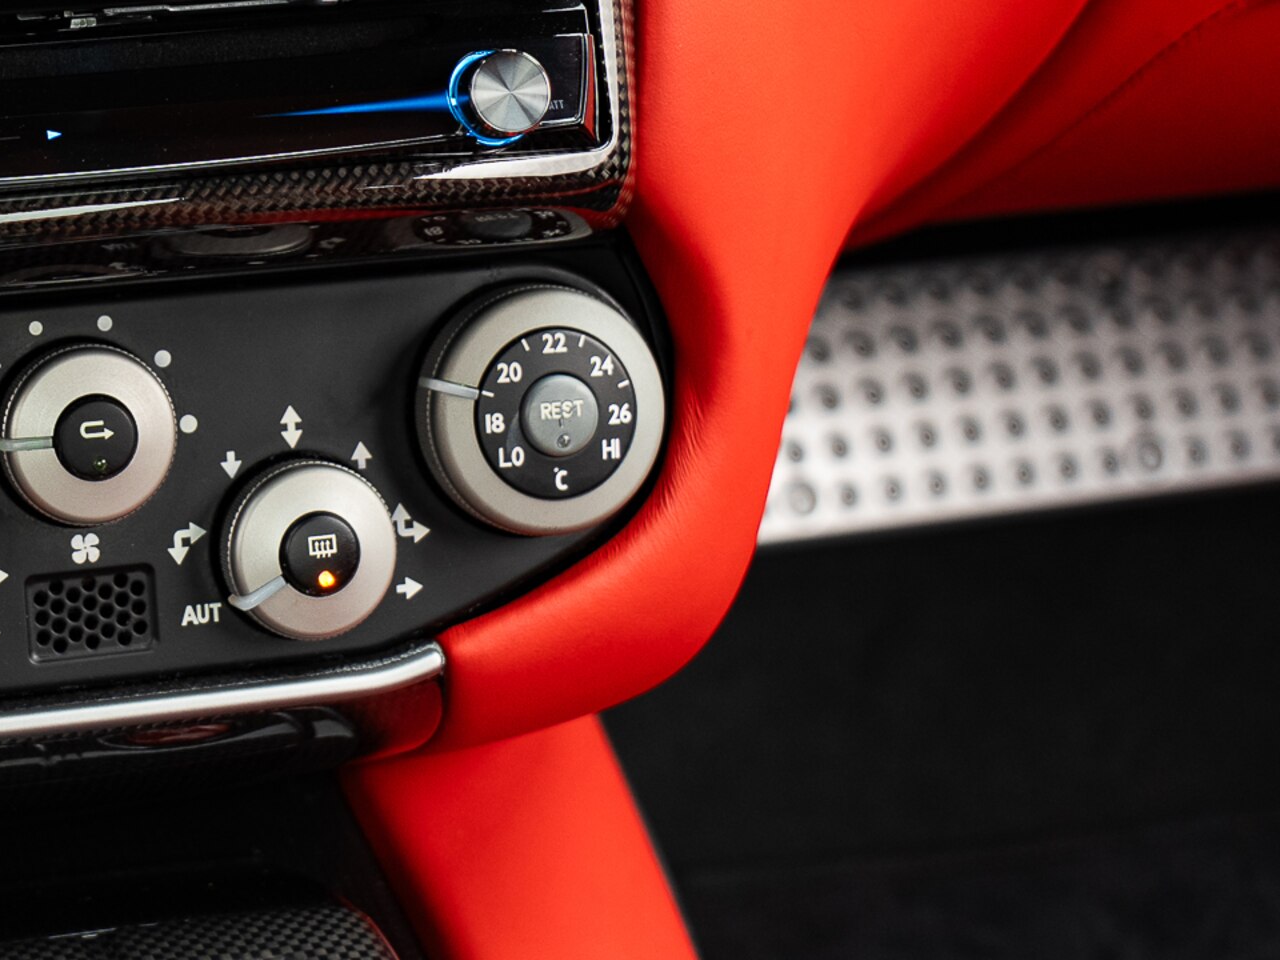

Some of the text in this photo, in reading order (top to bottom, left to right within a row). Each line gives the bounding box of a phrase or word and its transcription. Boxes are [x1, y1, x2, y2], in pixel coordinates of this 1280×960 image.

[541, 332, 568, 355] 22
[496, 360, 523, 385] 20
[589, 352, 615, 378] 24
[539, 398, 585, 420] REST
[607, 403, 634, 425] 26
[484, 413, 506, 435] 18
[497, 446, 526, 469] LO
[601, 438, 622, 461] HI
[181, 601, 223, 628] AUT
